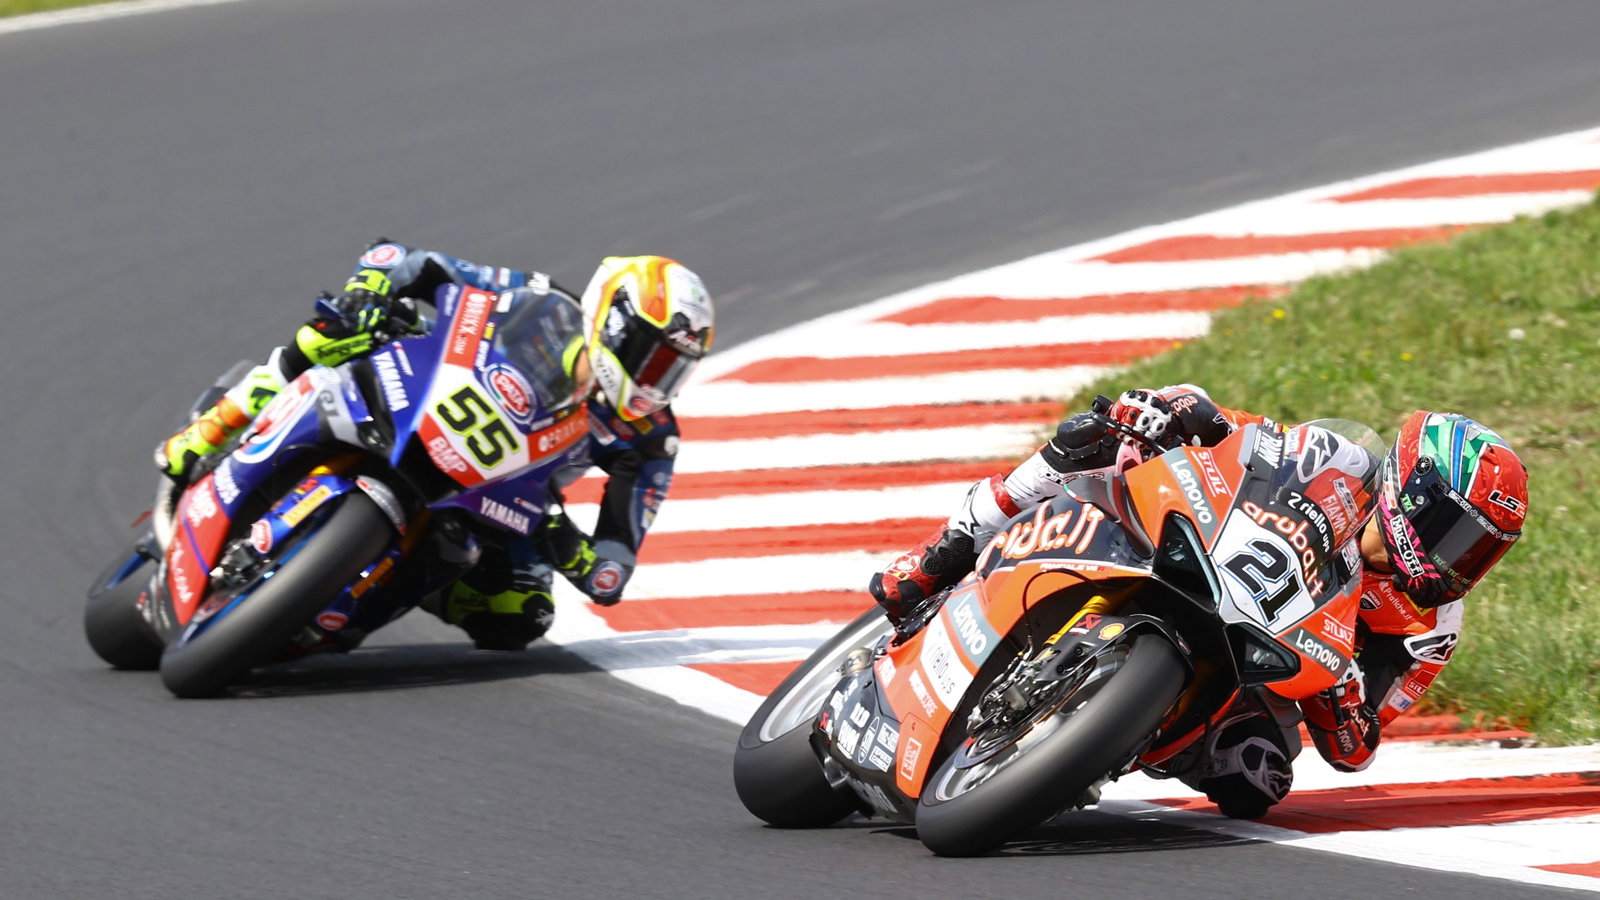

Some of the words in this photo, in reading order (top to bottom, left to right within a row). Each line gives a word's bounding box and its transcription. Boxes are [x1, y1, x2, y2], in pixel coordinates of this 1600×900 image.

[372, 351, 410, 412] YAMAHA
[427, 436, 467, 473] BMP
[436, 385, 520, 469] 55
[1170, 458, 1213, 526] Lenovo
[1197, 450, 1227, 496] STULZ
[480, 496, 530, 535] YAMAHA
[1299, 500, 1328, 536] riello
[1323, 535, 1331, 553] ups
[1322, 494, 1347, 535] FIAMM
[1488, 489, 1526, 519] LS2
[961, 498, 1104, 585] ruba.it
[1241, 500, 1325, 599] aruba.it
[1391, 517, 1423, 576] Muc-Off
[1220, 538, 1303, 626] 21
[952, 592, 987, 656] Lenovo
[1295, 628, 1341, 673] Lenovo
[1323, 618, 1354, 645] STULZ
